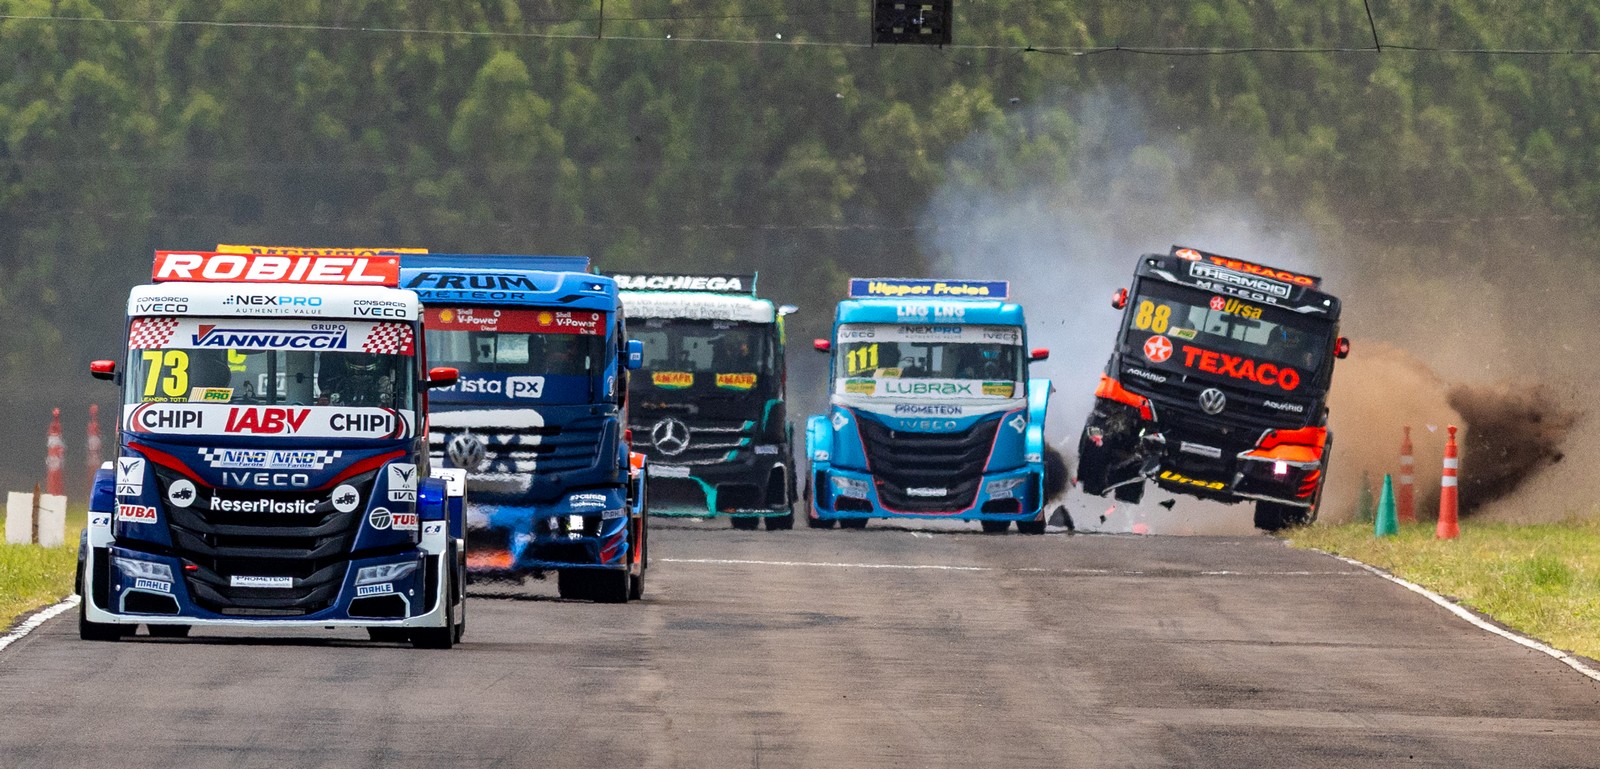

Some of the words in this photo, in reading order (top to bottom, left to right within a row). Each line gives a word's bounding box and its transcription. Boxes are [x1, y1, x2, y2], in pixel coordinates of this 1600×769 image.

[157, 254, 386, 282] ROBIEL
[1210, 256, 1313, 285] TEXACO
[407, 273, 539, 290] FRUM
[1194, 265, 1287, 296] THERMOID
[417, 290, 525, 299] METEOR
[1196, 280, 1277, 304] METEOR
[136, 304, 188, 312] IVECO
[236, 295, 322, 306] NEXPRO
[1224, 298, 1263, 319] Ursa
[354, 307, 406, 317] IVECO
[457, 315, 498, 324] V-Power
[1136, 300, 1171, 334] 88
[846, 343, 878, 374] 111
[142, 350, 189, 397] 73
[1182, 345, 1300, 391] TEXACO
[204, 392, 229, 400] PRO
[513, 381, 538, 397] px
[886, 382, 972, 395] LUBRAX
[895, 404, 962, 415] PROMETEON
[143, 410, 203, 428] CHIPI
[330, 413, 391, 432] CHIPI
[900, 420, 957, 429] IVECO
[223, 472, 309, 487] IVECO
[1160, 470, 1225, 490] Ursa
[120, 506, 155, 518] TUBA
[210, 497, 316, 514] ReserPlastic
[137, 580, 169, 591] MAHLE
[359, 584, 391, 595] MAHLE
